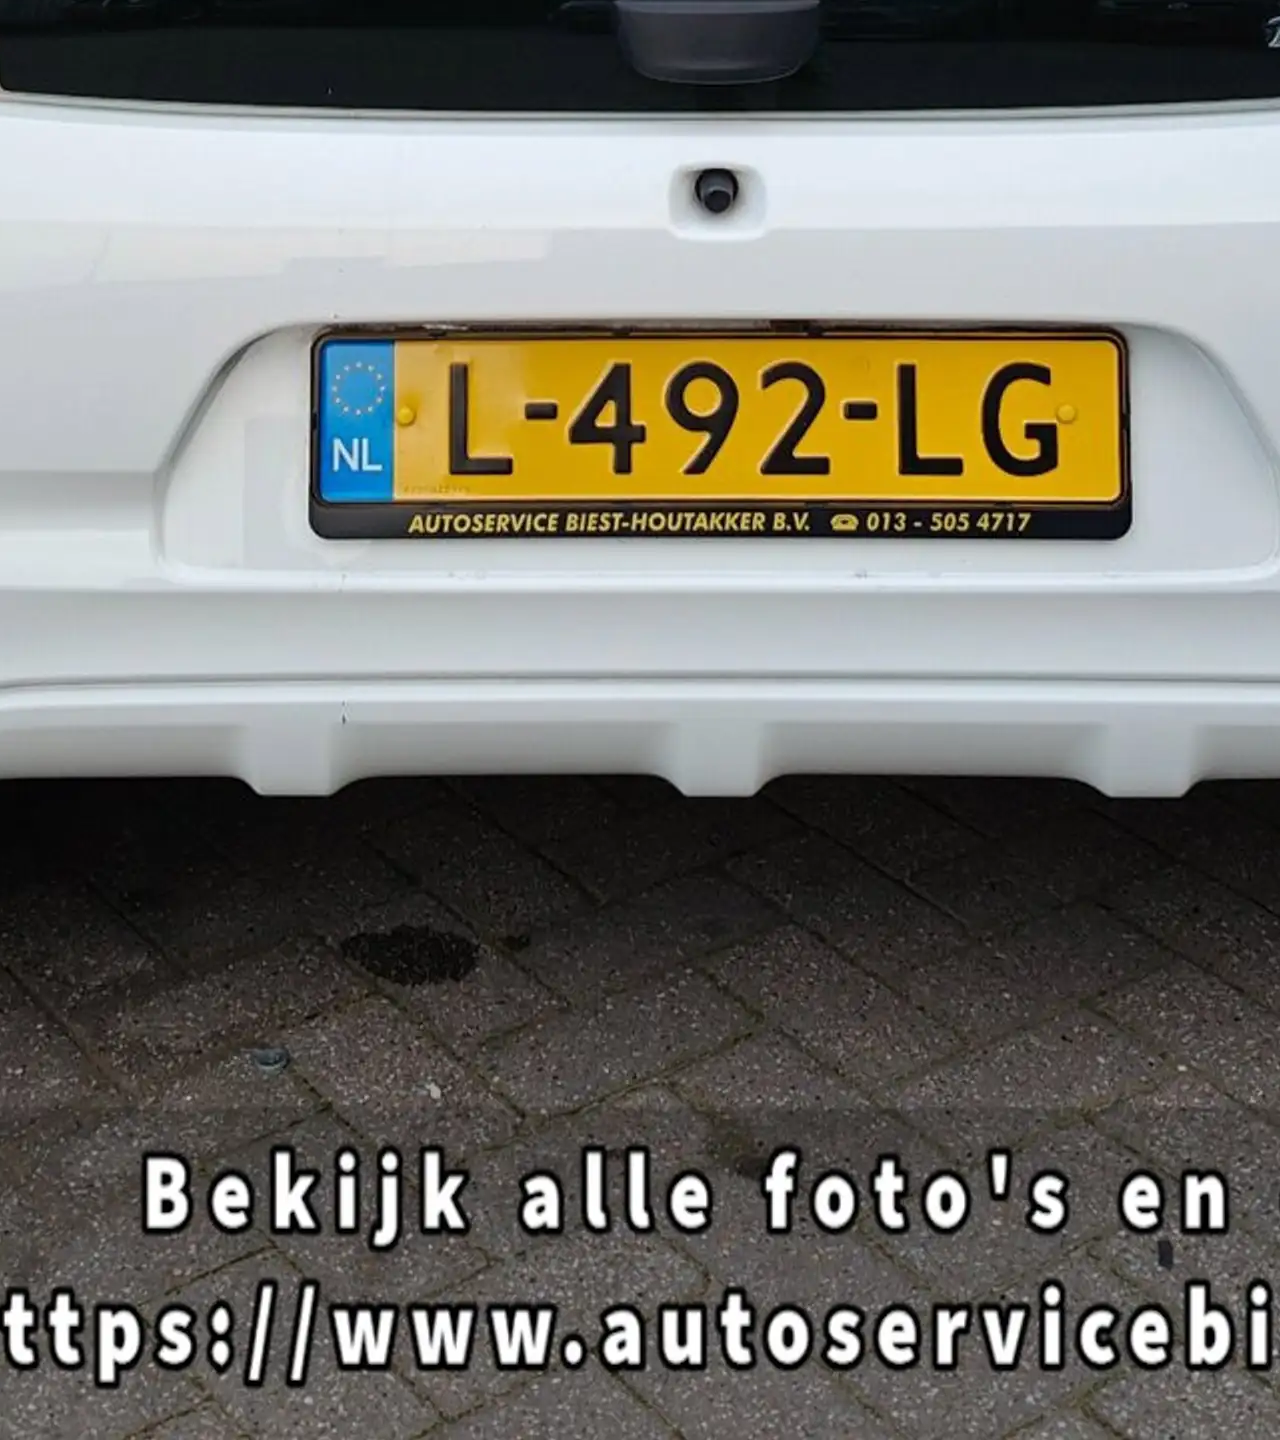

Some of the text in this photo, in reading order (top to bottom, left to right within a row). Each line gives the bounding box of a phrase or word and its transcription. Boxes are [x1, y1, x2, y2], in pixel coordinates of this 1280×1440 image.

[448, 360, 1061, 477] L-492-LG
[332, 437, 383, 472] NL
[407, 513, 559, 534] AUTOSERVICE
[565, 512, 766, 533] BIEST-HOUTAKKER
[772, 512, 812, 532] B.V.
[866, 512, 907, 532] 013
[929, 512, 970, 532] 505
[975, 512, 1033, 532] 4717
